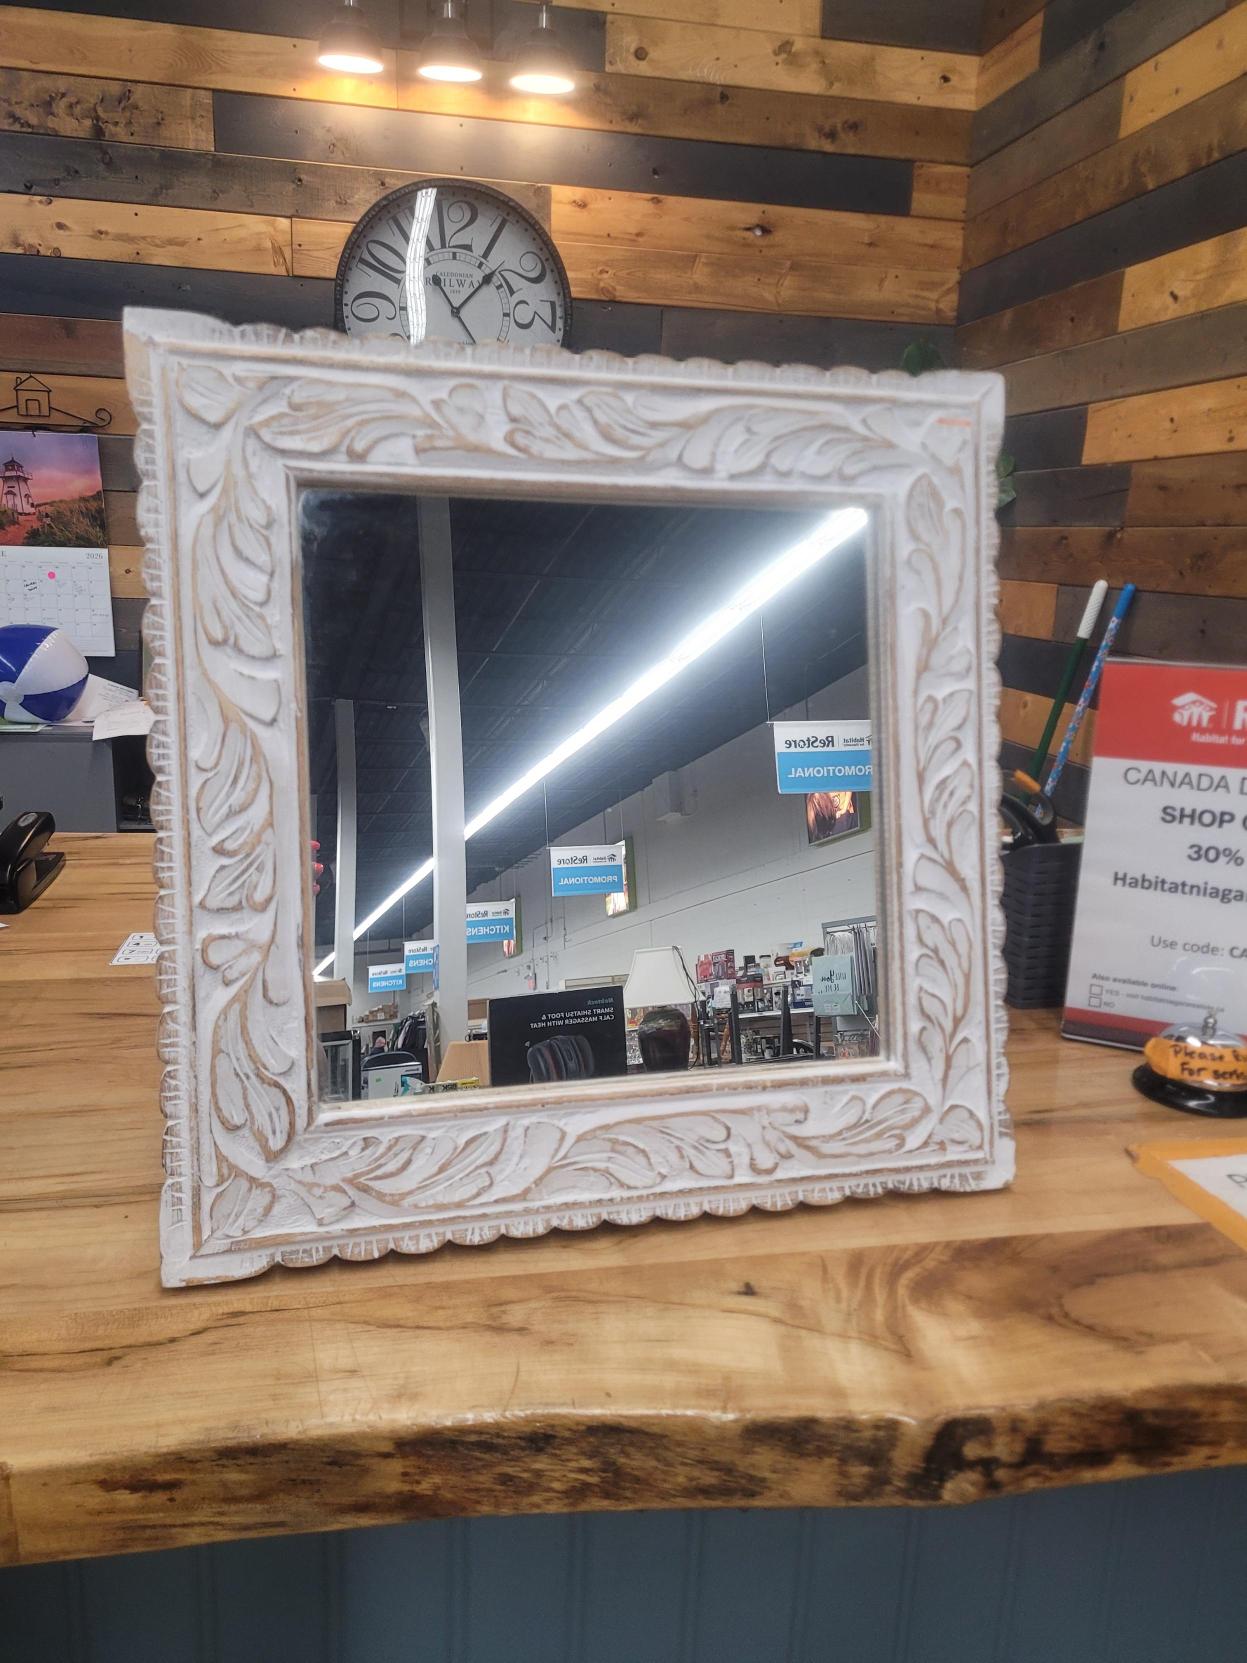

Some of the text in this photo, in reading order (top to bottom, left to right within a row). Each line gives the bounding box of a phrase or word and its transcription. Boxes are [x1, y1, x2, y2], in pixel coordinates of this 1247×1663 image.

[434, 198, 479, 253] 12
[356, 239, 406, 288] 10
[499, 250, 547, 297] 2
[425, 277, 483, 289] RILWA
[351, 290, 397, 323] 9
[512, 299, 557, 334] 3
[1123, 767, 1231, 794] CANADA
[1160, 805, 1235, 829] SHOP
[1187, 844, 1245, 867] 30%
[1112, 871, 1247, 904] Habitatniaga
[1150, 935, 1178, 951] Use
[1182, 939, 1225, 958] code:
[1091, 973, 1110, 982] Also
[1112, 977, 1149, 988] available
[1169, 1043, 1225, 1061] Please
[1180, 1061, 1208, 1077] For
